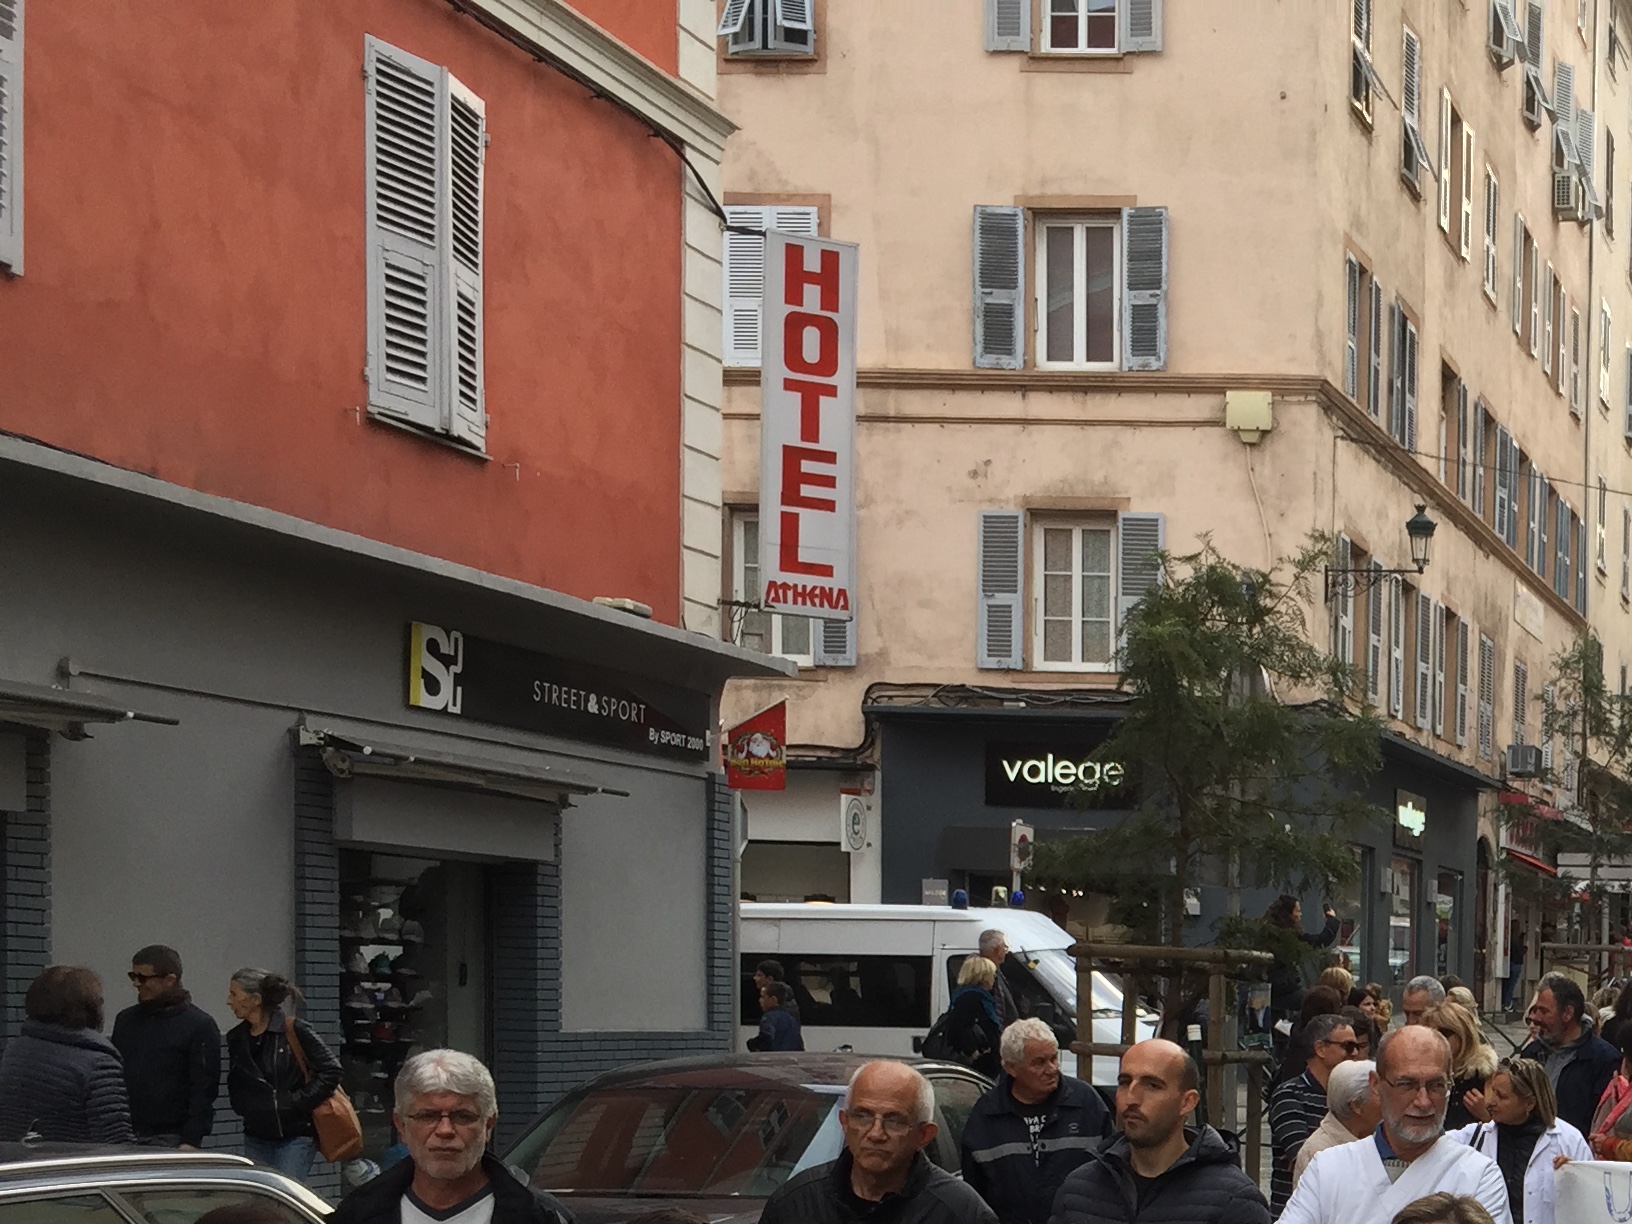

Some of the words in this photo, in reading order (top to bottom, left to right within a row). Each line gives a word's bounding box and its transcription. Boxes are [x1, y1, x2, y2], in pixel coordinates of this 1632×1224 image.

[779, 242, 840, 579] HOTEL
[764, 580, 849, 611] ATHENA
[532, 680, 646, 724] STREET&SPORT
[660, 731, 686, 748] SPORT
[1002, 753, 1125, 791] valege
